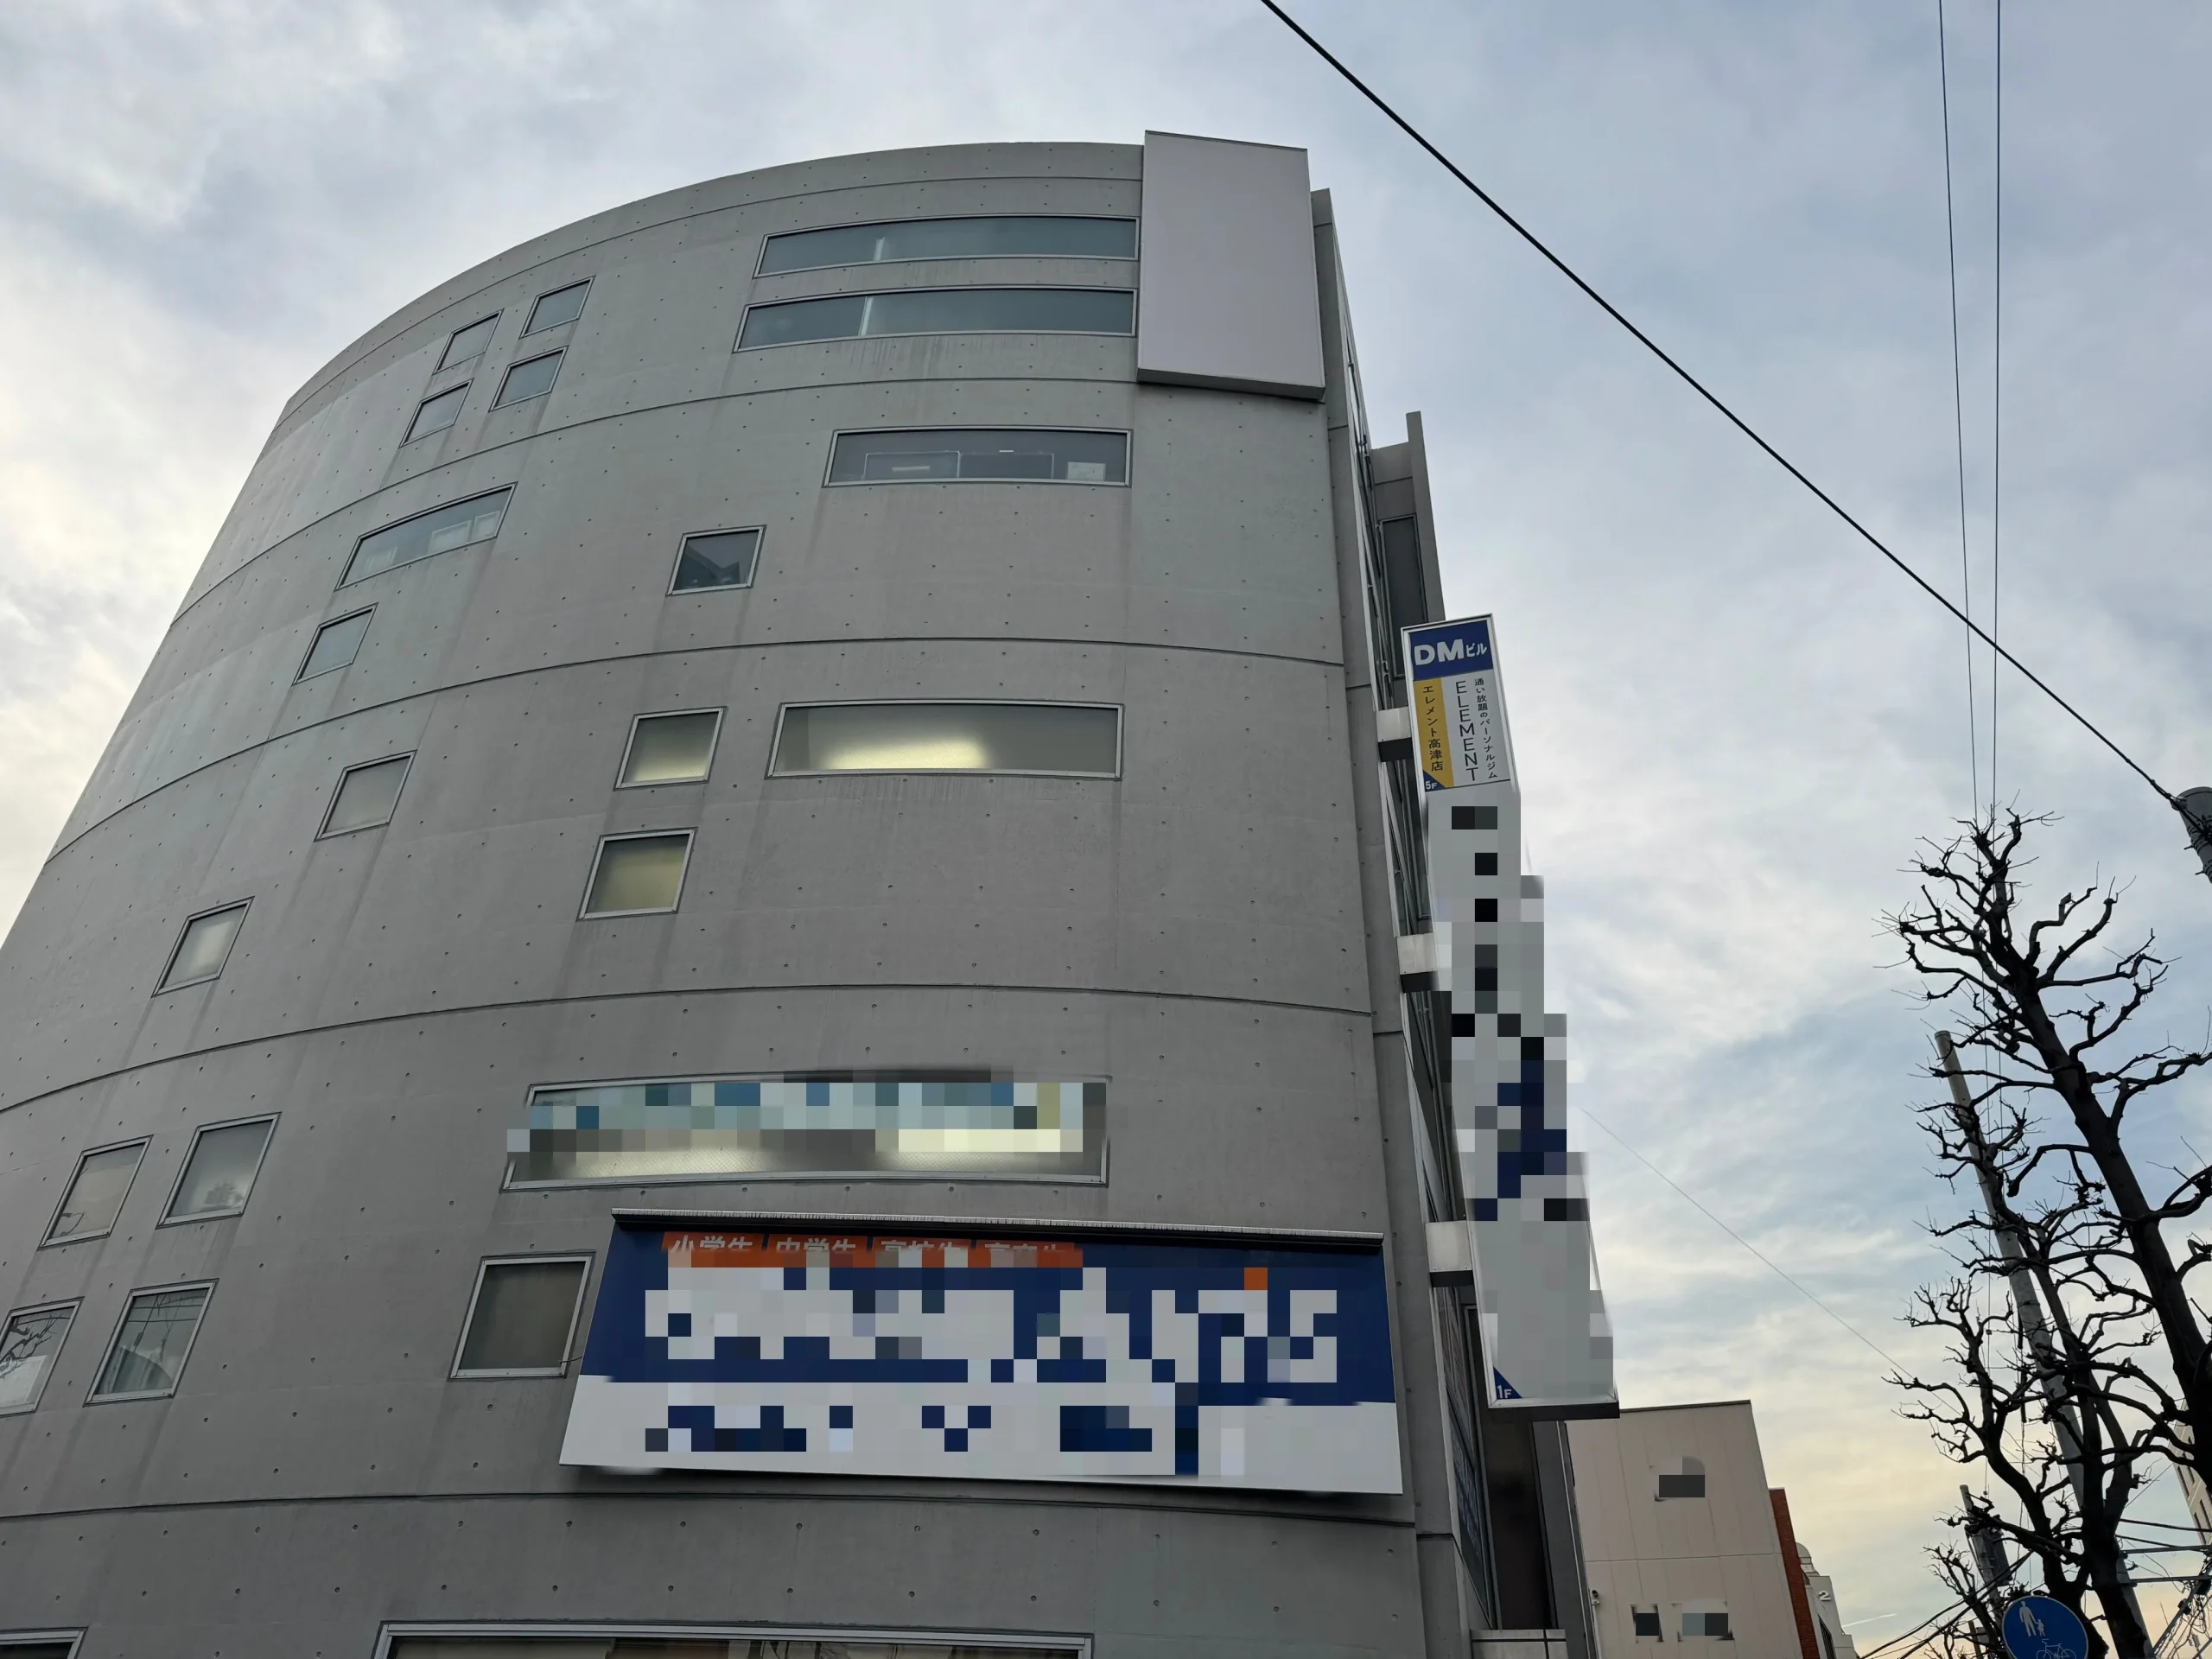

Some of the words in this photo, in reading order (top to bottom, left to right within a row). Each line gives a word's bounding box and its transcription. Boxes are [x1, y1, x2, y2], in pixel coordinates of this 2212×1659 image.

[1414, 639, 1487, 666] DMビル
[1422, 685, 1444, 772] エレメント高津店
[1455, 680, 1479, 781] ELEMENT
[1474, 677, 1497, 779] 通い放題のパーソナルジム
[1426, 781, 1438, 790] 5F
[1497, 1385, 1512, 1399] 1F
